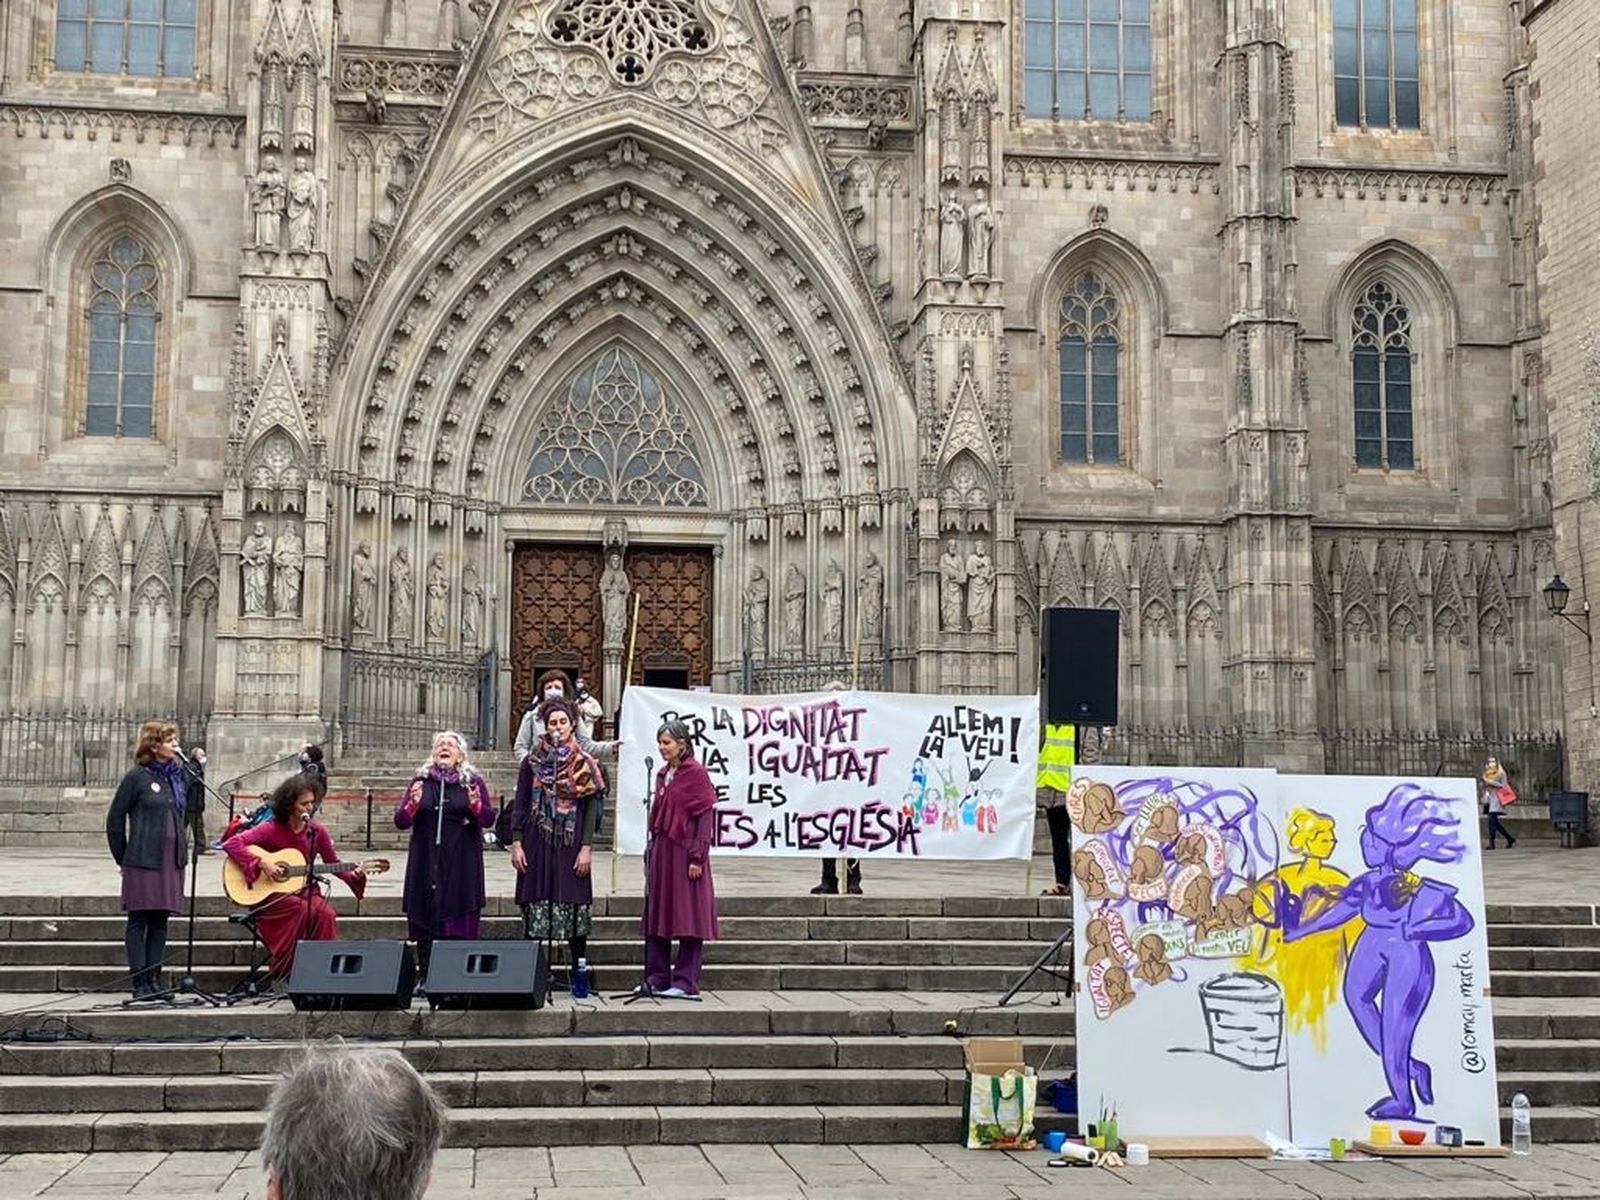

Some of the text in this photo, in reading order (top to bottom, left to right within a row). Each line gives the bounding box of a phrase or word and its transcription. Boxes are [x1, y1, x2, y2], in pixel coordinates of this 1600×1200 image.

[712, 706, 736, 736] LA
[742, 700, 867, 747] DIGNITAT
[919, 736, 944, 759] LA
[749, 741, 889, 787] IGUALTAT
[747, 782, 787, 808] LES
[763, 819, 782, 849] A
